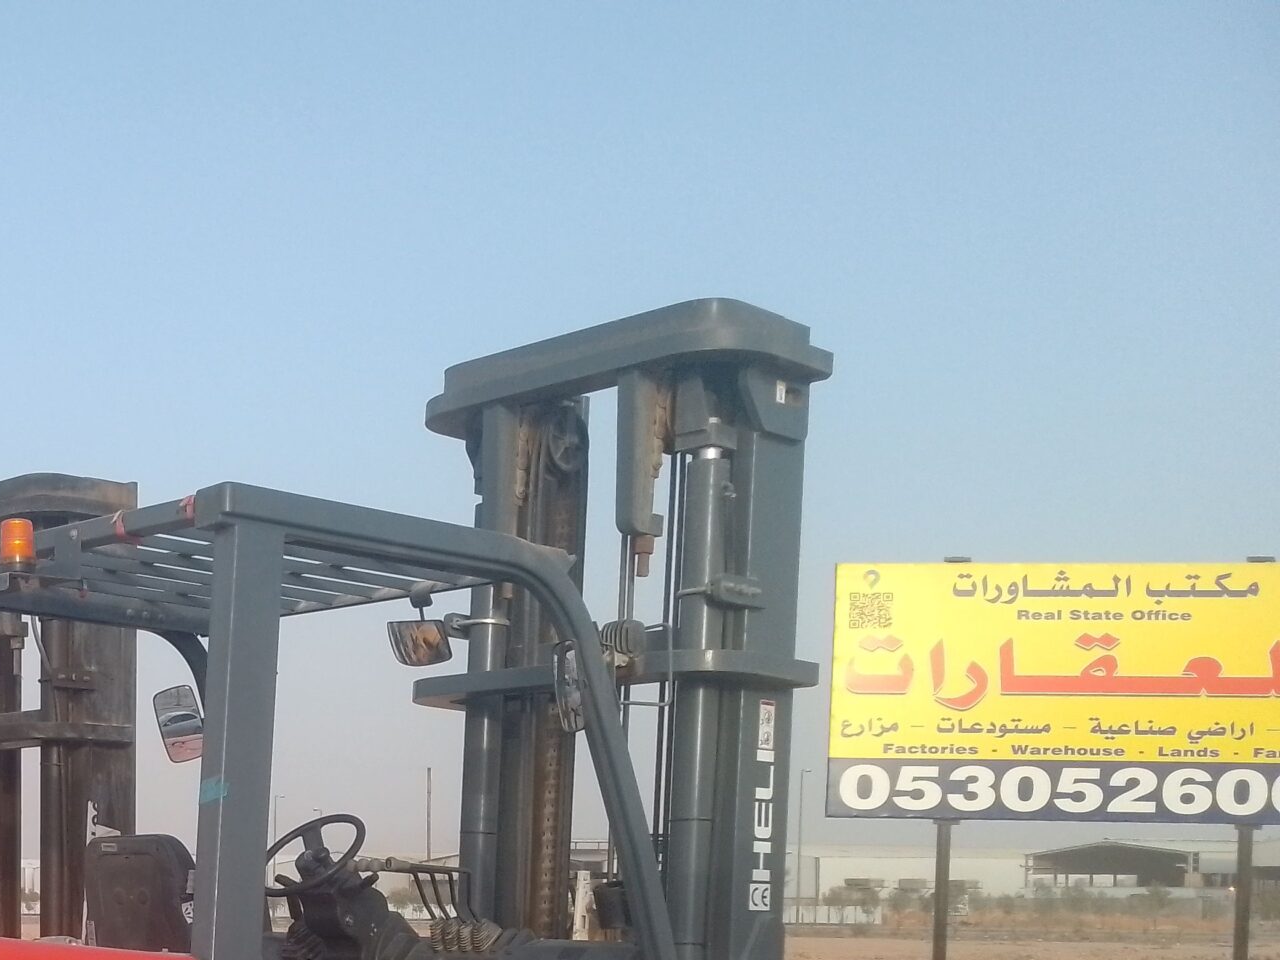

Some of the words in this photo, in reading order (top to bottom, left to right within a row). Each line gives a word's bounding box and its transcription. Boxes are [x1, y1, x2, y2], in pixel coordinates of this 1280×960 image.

[952, 569, 1132, 605] المشاورات
[1145, 572, 1260, 605] مكتب
[1016, 609, 1062, 622] Real
[1069, 609, 1124, 622] State
[1131, 609, 1193, 622] Office
[839, 716, 899, 738] مزارع
[936, 716, 1052, 738] مستودعات
[1088, 716, 1178, 741] صناعية
[1186, 720, 1255, 745] اراضي
[882, 743, 979, 756] Factories
[1011, 744, 1126, 757] Warehouse
[1157, 746, 1220, 758] Lands
[1253, 748, 1280, 759] Fa
[839, 763, 1280, 816] 05305260
[752, 749, 775, 882] HELI
